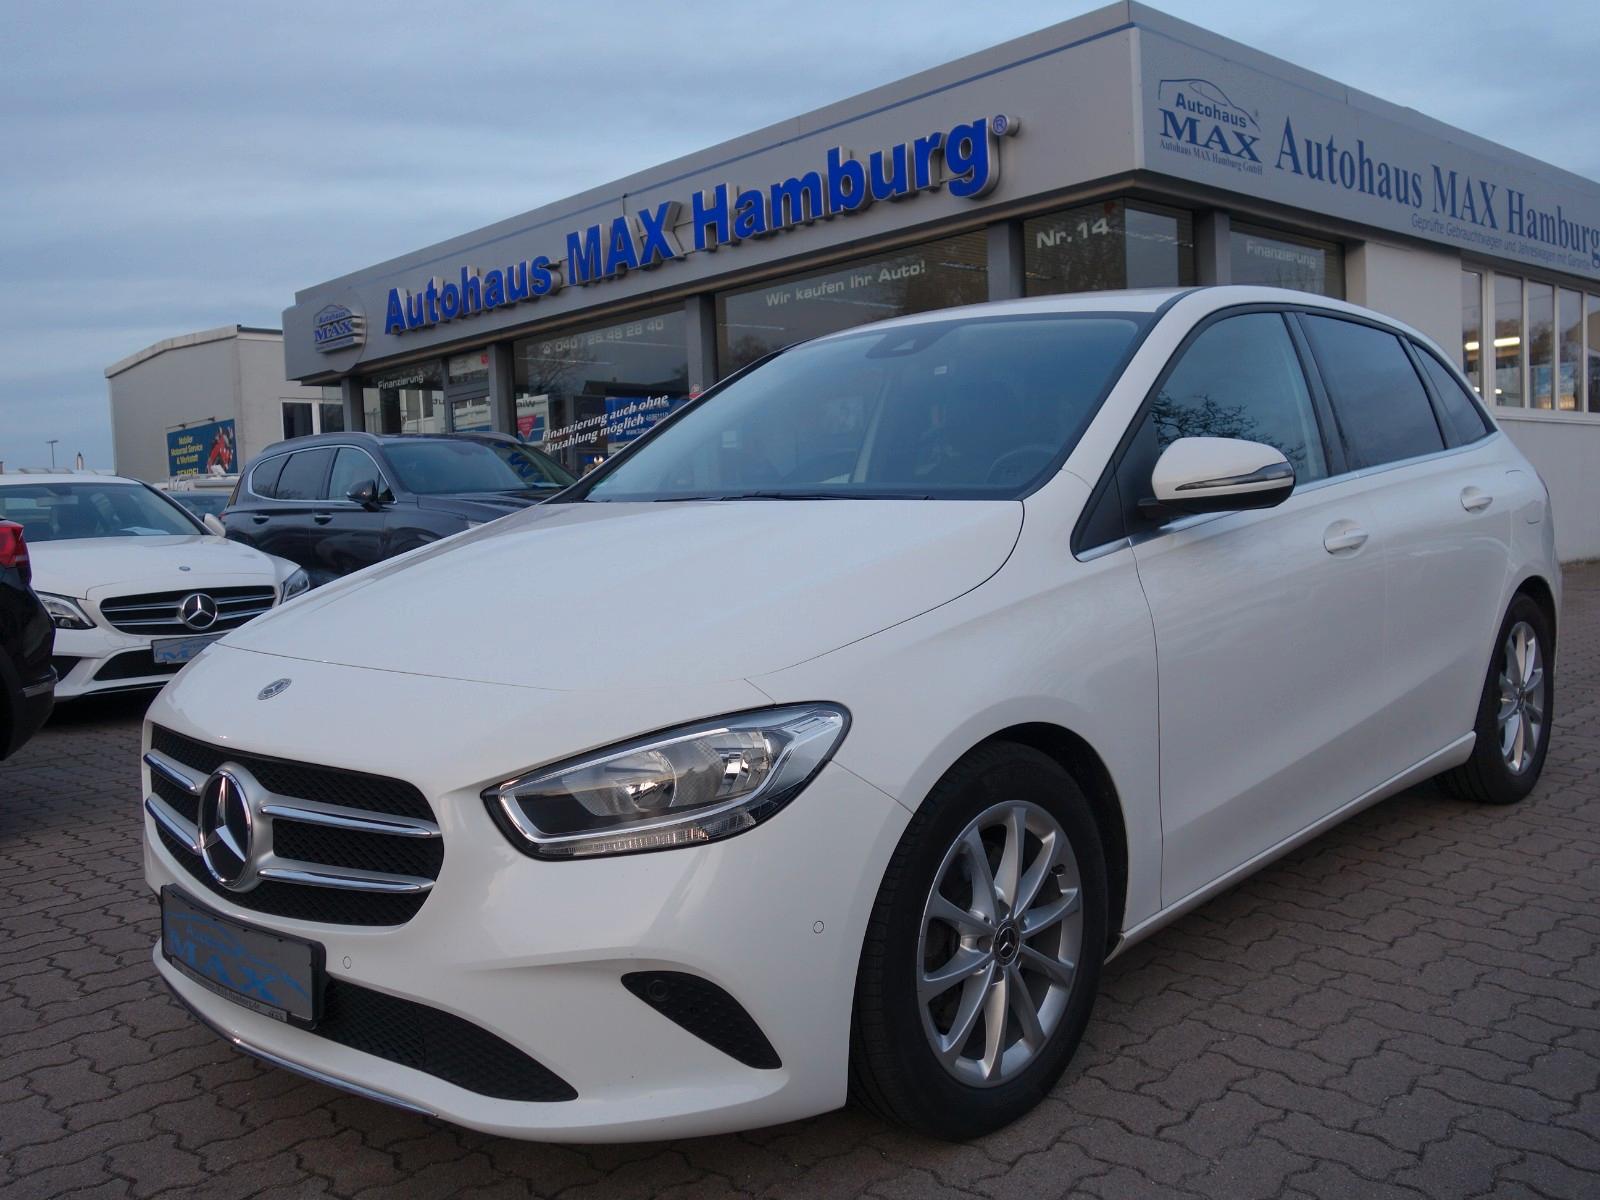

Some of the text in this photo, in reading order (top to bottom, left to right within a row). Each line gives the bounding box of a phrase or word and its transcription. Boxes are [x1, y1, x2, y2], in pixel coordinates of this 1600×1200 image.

[1175, 92, 1247, 128] Autohaus
[1158, 108, 1262, 163] MAX
[1274, 115, 1600, 269] Autohaus MAX Hamburg
[385, 117, 990, 335] Autohaus MAX Hamburg
[1036, 217, 1110, 249] Nr. 14
[1246, 240, 1317, 269] Finanzierung
[766, 259, 926, 307] Wir kaufen Ihr Auto!
[314, 320, 353, 342] MAX
[377, 374, 424, 390] Finanzierung
[542, 414, 608, 441] Finanzierung
[609, 404, 637, 420] auch
[639, 394, 669, 411] ohne
[544, 429, 599, 453] Anzahlung
[600, 413, 645, 437] möglich
